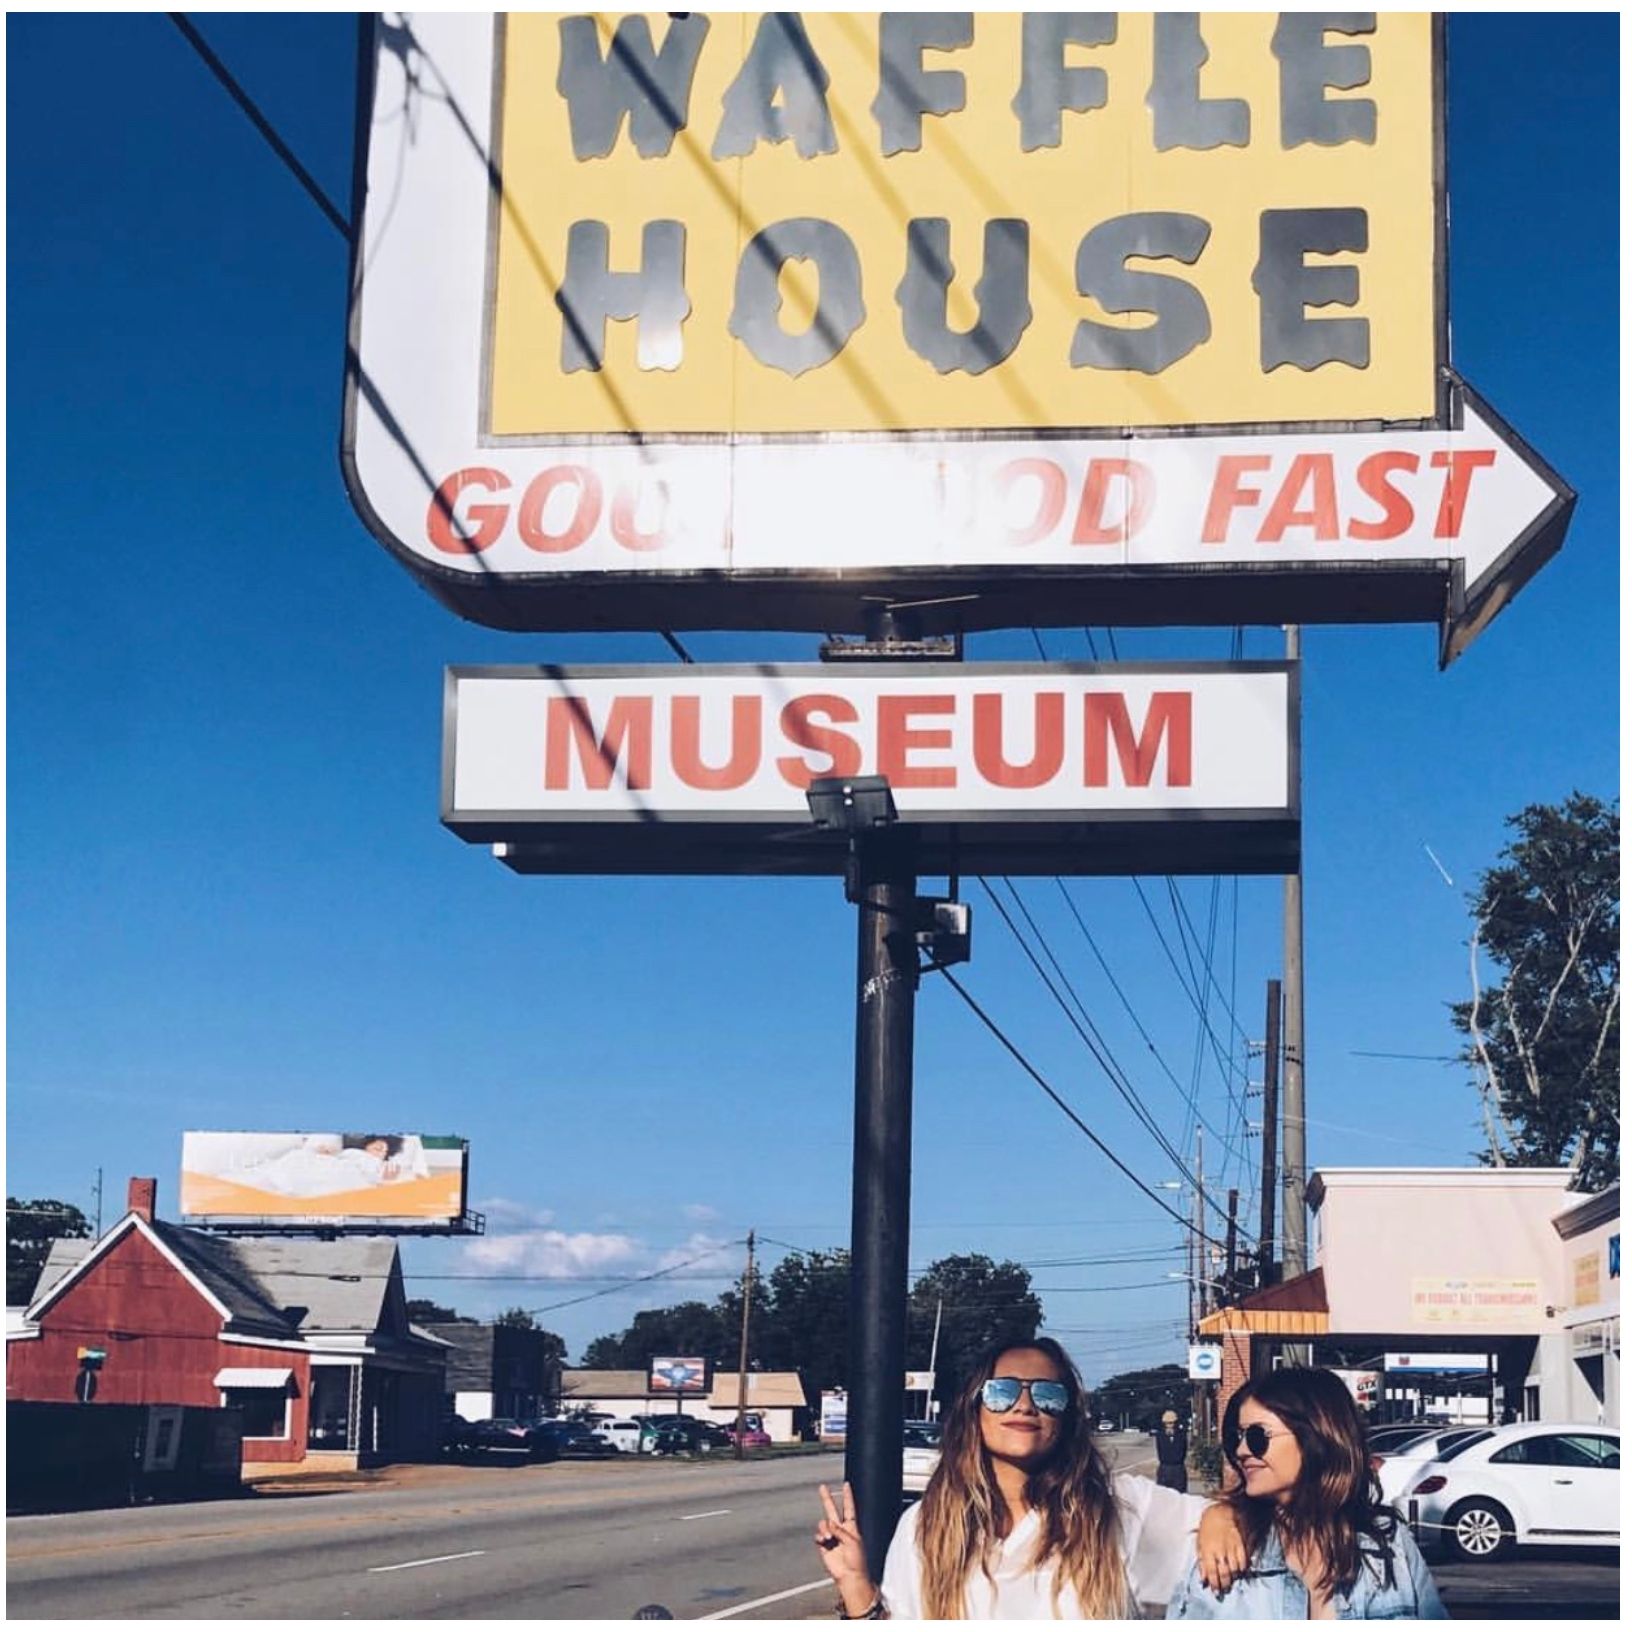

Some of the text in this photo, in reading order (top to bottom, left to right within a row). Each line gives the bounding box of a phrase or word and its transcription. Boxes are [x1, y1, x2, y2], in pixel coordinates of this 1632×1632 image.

[556, 12, 1378, 161] WAFFLE
[554, 206, 1371, 379] HOUSE
[423, 463, 696, 555] GOO
[1201, 447, 1497, 546] FAST
[543, 690, 1194, 792] MUSEUM
